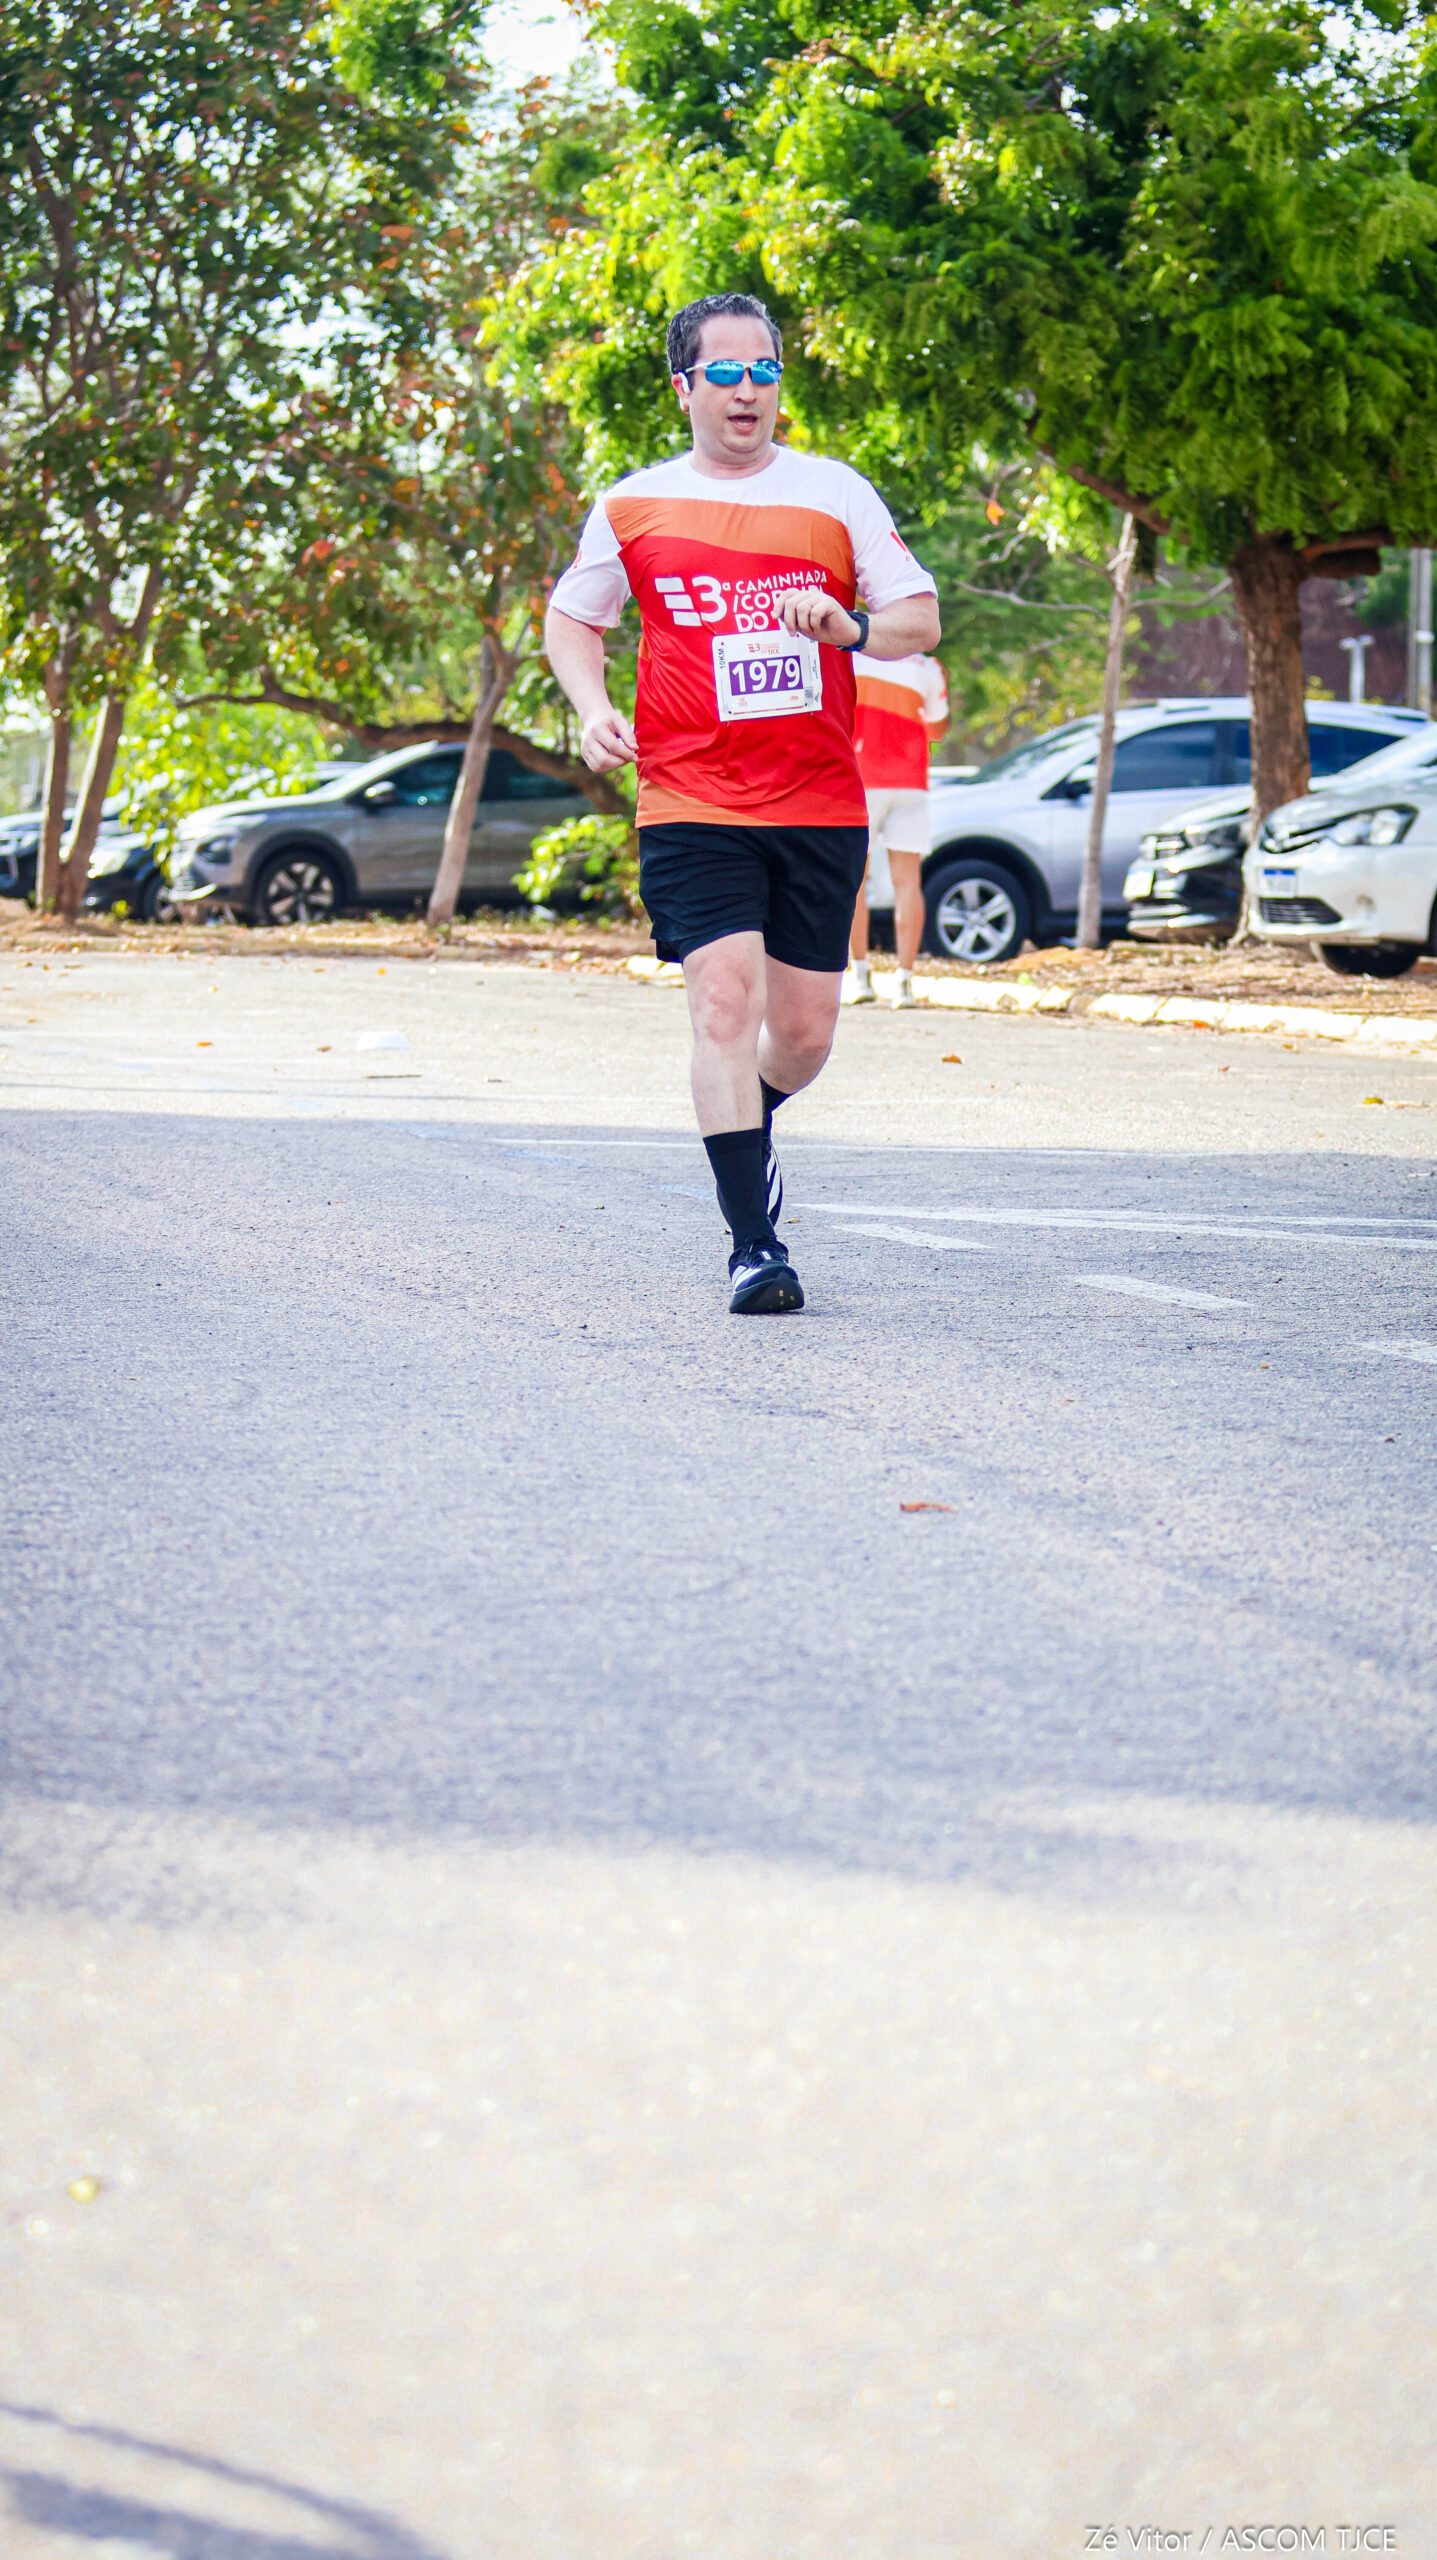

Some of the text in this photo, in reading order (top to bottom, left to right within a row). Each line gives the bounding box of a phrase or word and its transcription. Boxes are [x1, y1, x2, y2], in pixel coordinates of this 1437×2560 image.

[735, 569, 828, 594] CAMINHADA
[735, 611, 769, 633] DO
[718, 648, 726, 669] 10KM
[732, 657, 801, 693] 1979
